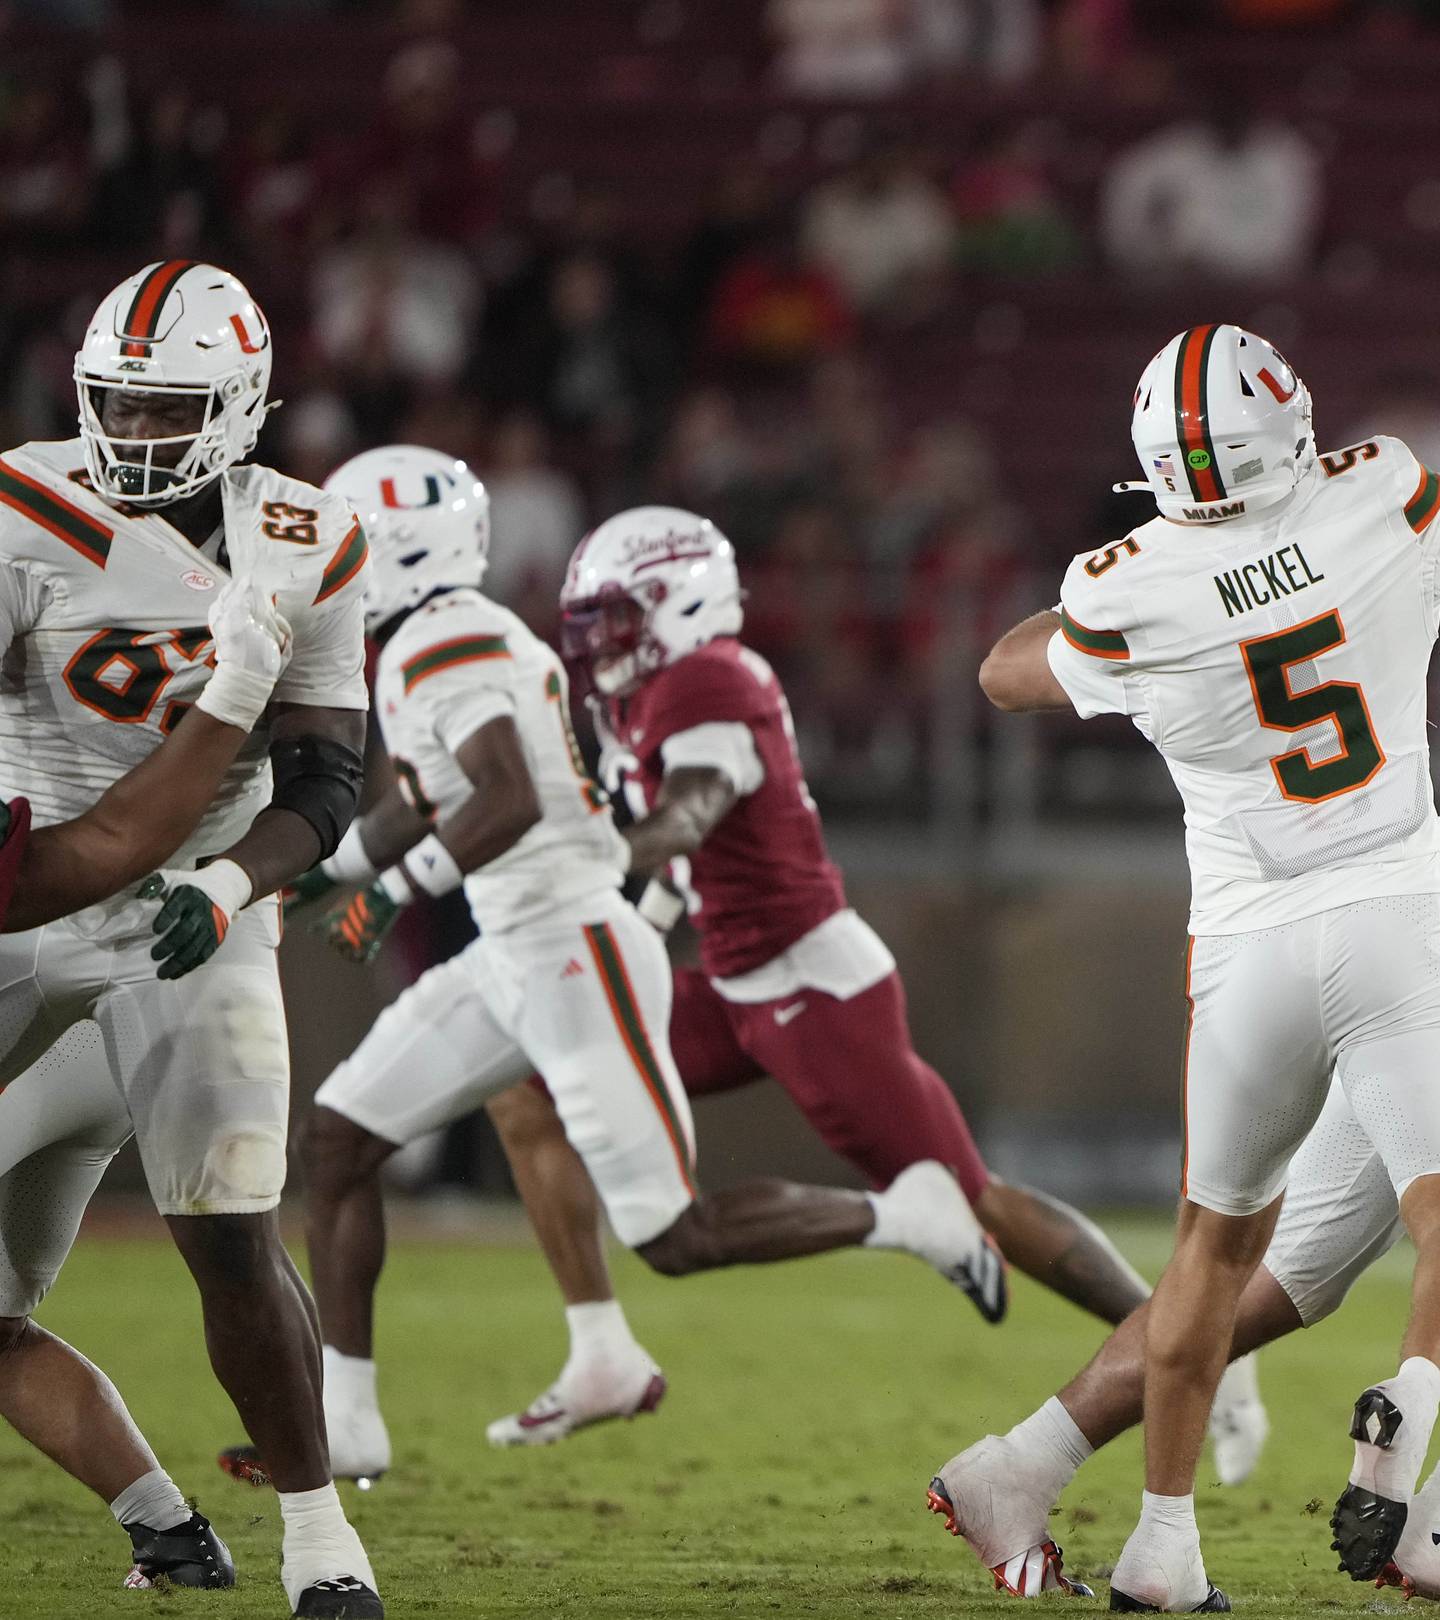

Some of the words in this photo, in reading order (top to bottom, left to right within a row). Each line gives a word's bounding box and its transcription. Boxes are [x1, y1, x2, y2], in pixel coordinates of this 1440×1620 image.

[1190, 454, 1209, 465] C2P
[1319, 441, 1381, 477] 5
[1164, 477, 1176, 493] 5
[262, 501, 320, 545] 63
[1182, 501, 1245, 520] MIAMI
[1083, 536, 1141, 578] 5
[1213, 543, 1325, 618] NICKEL
[1239, 608, 1387, 800] 5
